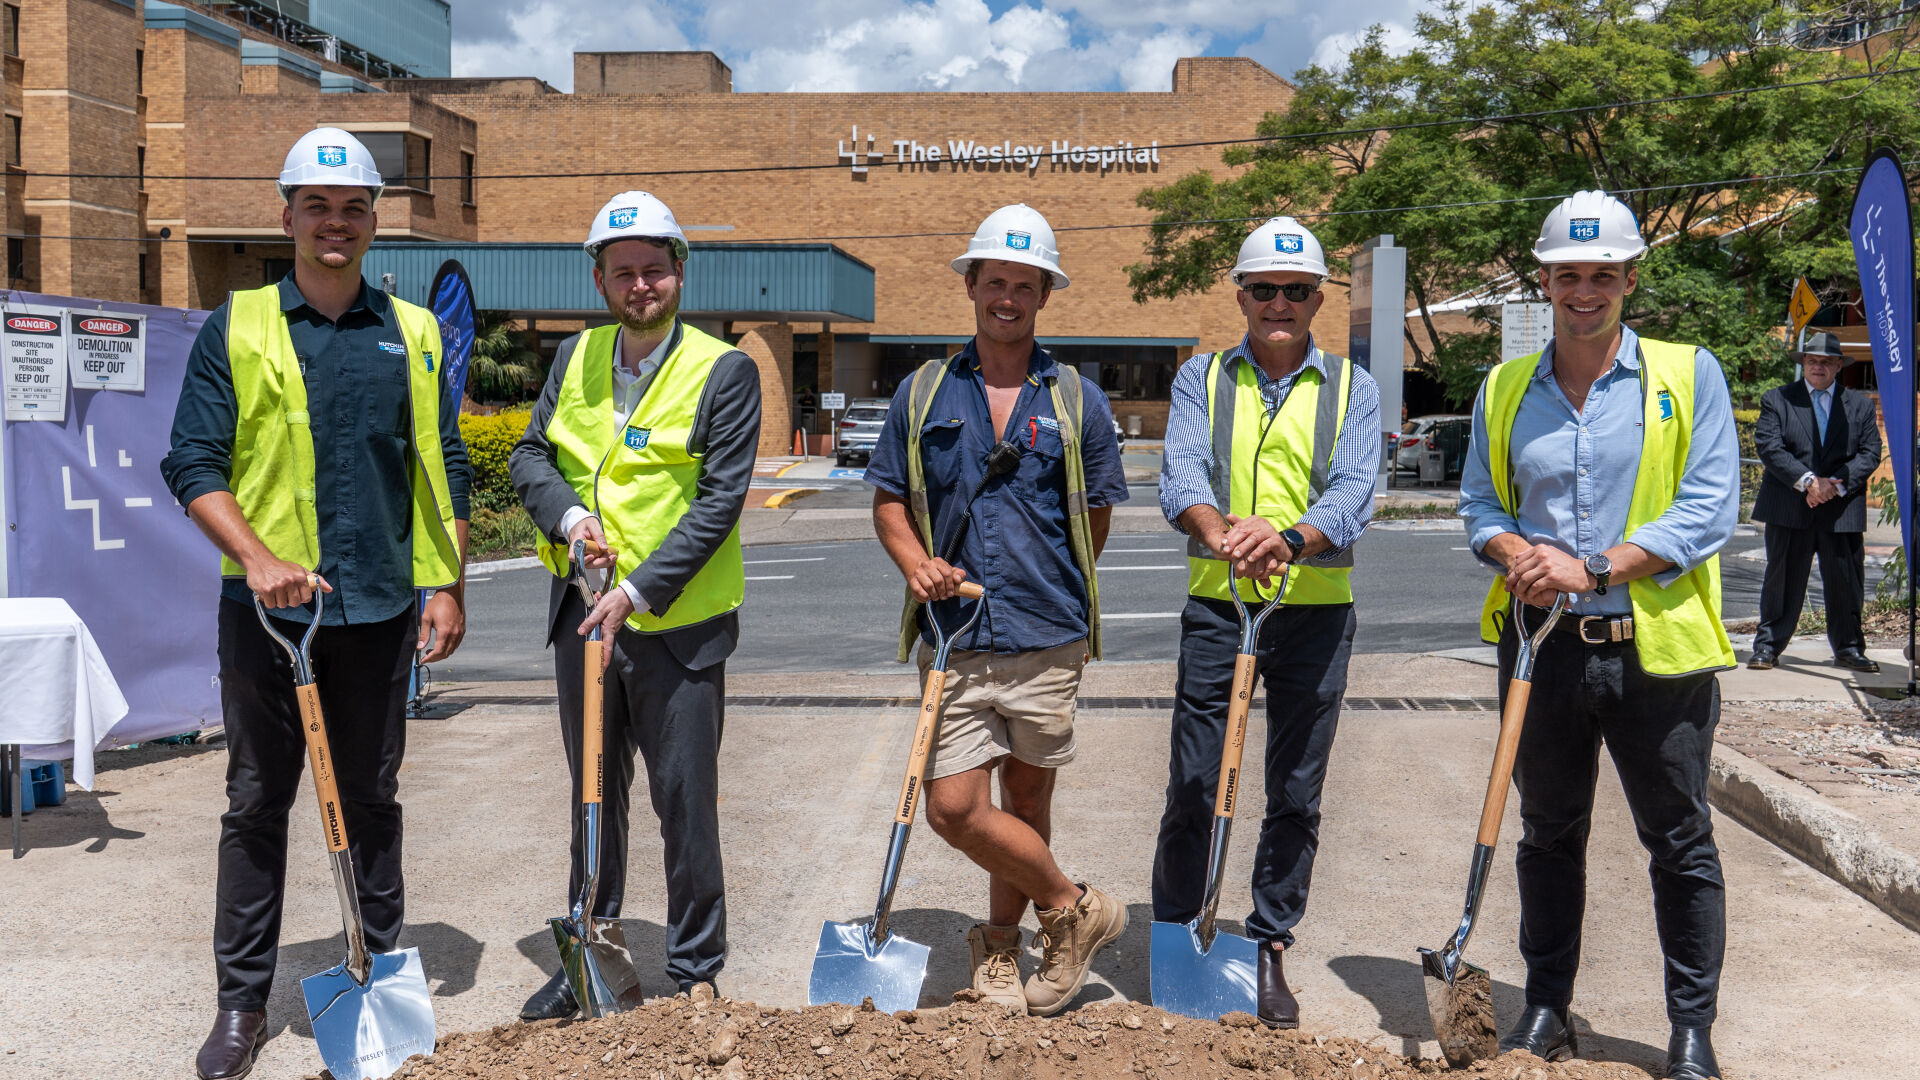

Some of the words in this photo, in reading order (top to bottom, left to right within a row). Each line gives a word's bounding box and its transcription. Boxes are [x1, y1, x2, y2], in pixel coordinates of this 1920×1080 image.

[323, 154, 341, 162] 115
[893, 140, 941, 163] The
[948, 140, 1043, 168] Wesley
[1051, 140, 1160, 168] Hospital
[613, 215, 632, 225] 110
[1575, 227, 1594, 236] 115
[1010, 238, 1026, 247] 110
[14, 320, 51, 331] DANGER
[88, 321, 124, 332] DANGER
[12, 340, 54, 349] CONSTRUCTION
[78, 338, 132, 353] DEMOLITION
[12, 356, 54, 365] UNAUTHORISED
[83, 360, 105, 373] KEEP
[107, 362, 125, 373] OUT
[15, 373, 32, 383] KEEP
[34, 374, 50, 383] OUT
[629, 436, 646, 447] 110
[1224, 768, 1237, 812] HUTCHIES
[902, 776, 917, 818] HUTCHIES
[326, 801, 342, 847] HUTCHIES
[360, 1050, 385, 1063] WESLEY
